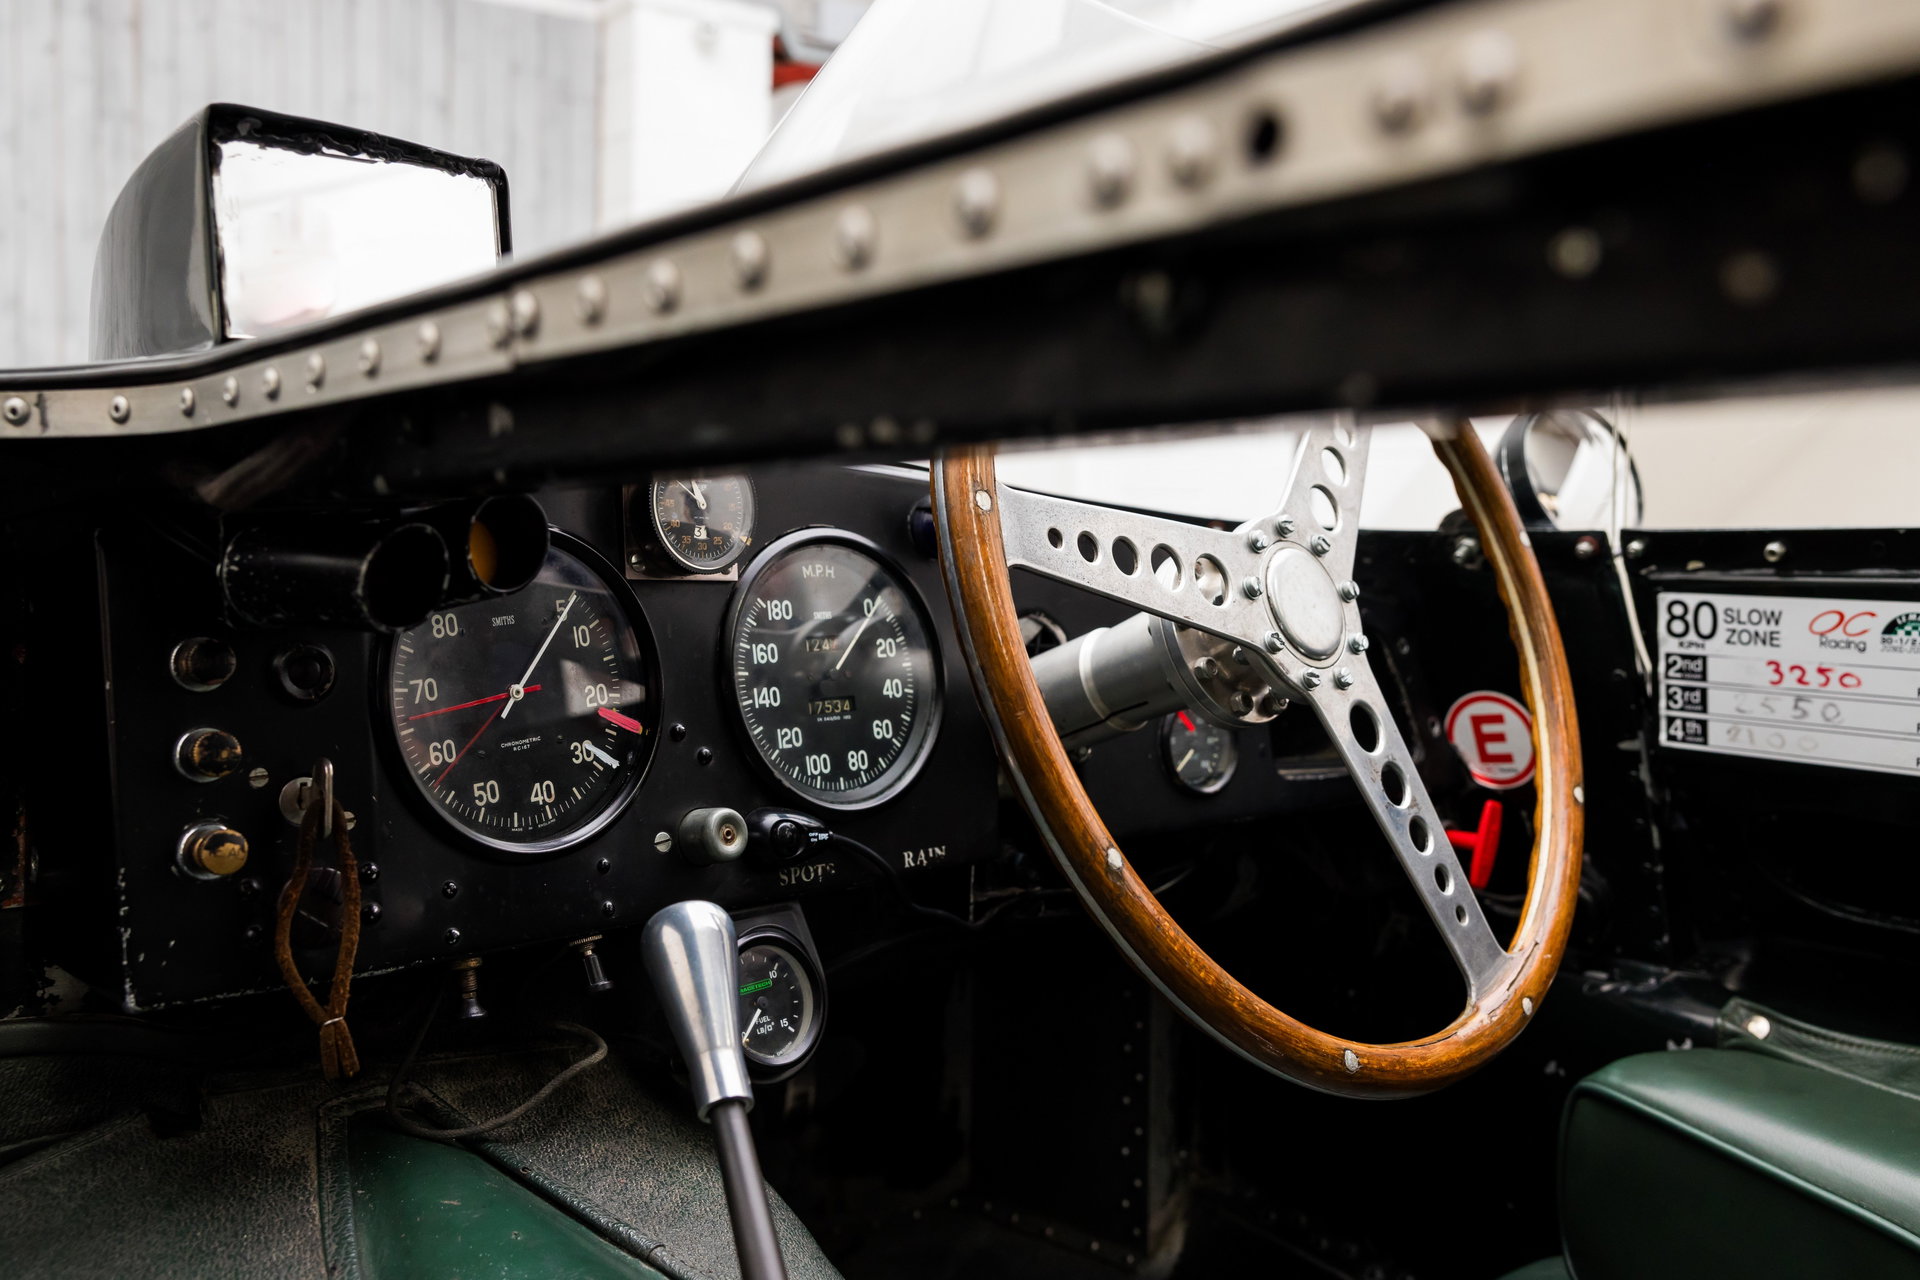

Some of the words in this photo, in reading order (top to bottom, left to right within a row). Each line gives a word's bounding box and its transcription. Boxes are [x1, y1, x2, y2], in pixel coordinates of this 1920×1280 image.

[681, 535, 692, 544] 35
[697, 542, 708, 551] 30
[713, 536, 723, 545] 25
[767, 600, 793, 621] 180
[863, 598, 873, 616] 0
[1723, 607, 1783, 627] SLOW
[431, 613, 459, 639] 80
[491, 614, 515, 627] SMITHS
[1666, 600, 1718, 640] 80
[1808, 609, 1878, 637] OC
[573, 625, 591, 648] 10
[1725, 629, 1781, 648] ZONE
[1819, 634, 1867, 653] Racing
[752, 643, 778, 664] 160
[876, 638, 897, 658] 20
[1667, 655, 1703, 678] 2nd
[1766, 660, 1862, 688] 3250
[409, 677, 438, 704] 70
[585, 683, 609, 708] 20
[754, 687, 781, 708] 140
[882, 679, 903, 699] 40
[1668, 687, 1702, 711] 3rd
[808, 699, 851, 715] 17534
[777, 727, 803, 749] 120
[872, 719, 893, 740] 60
[1470, 713, 1514, 763] E
[1668, 719, 1702, 742] 4th
[429, 739, 457, 766] 60
[500, 736, 542, 749] CHRONOMETRIC
[570, 740, 595, 764] 30
[805, 754, 831, 776] 100
[848, 750, 868, 771] 80
[473, 780, 499, 805] 50
[530, 780, 556, 805] 40
[902, 845, 947, 868] RAIN
[768, 970, 777, 979] 10
[780, 1018, 789, 1028] 15
